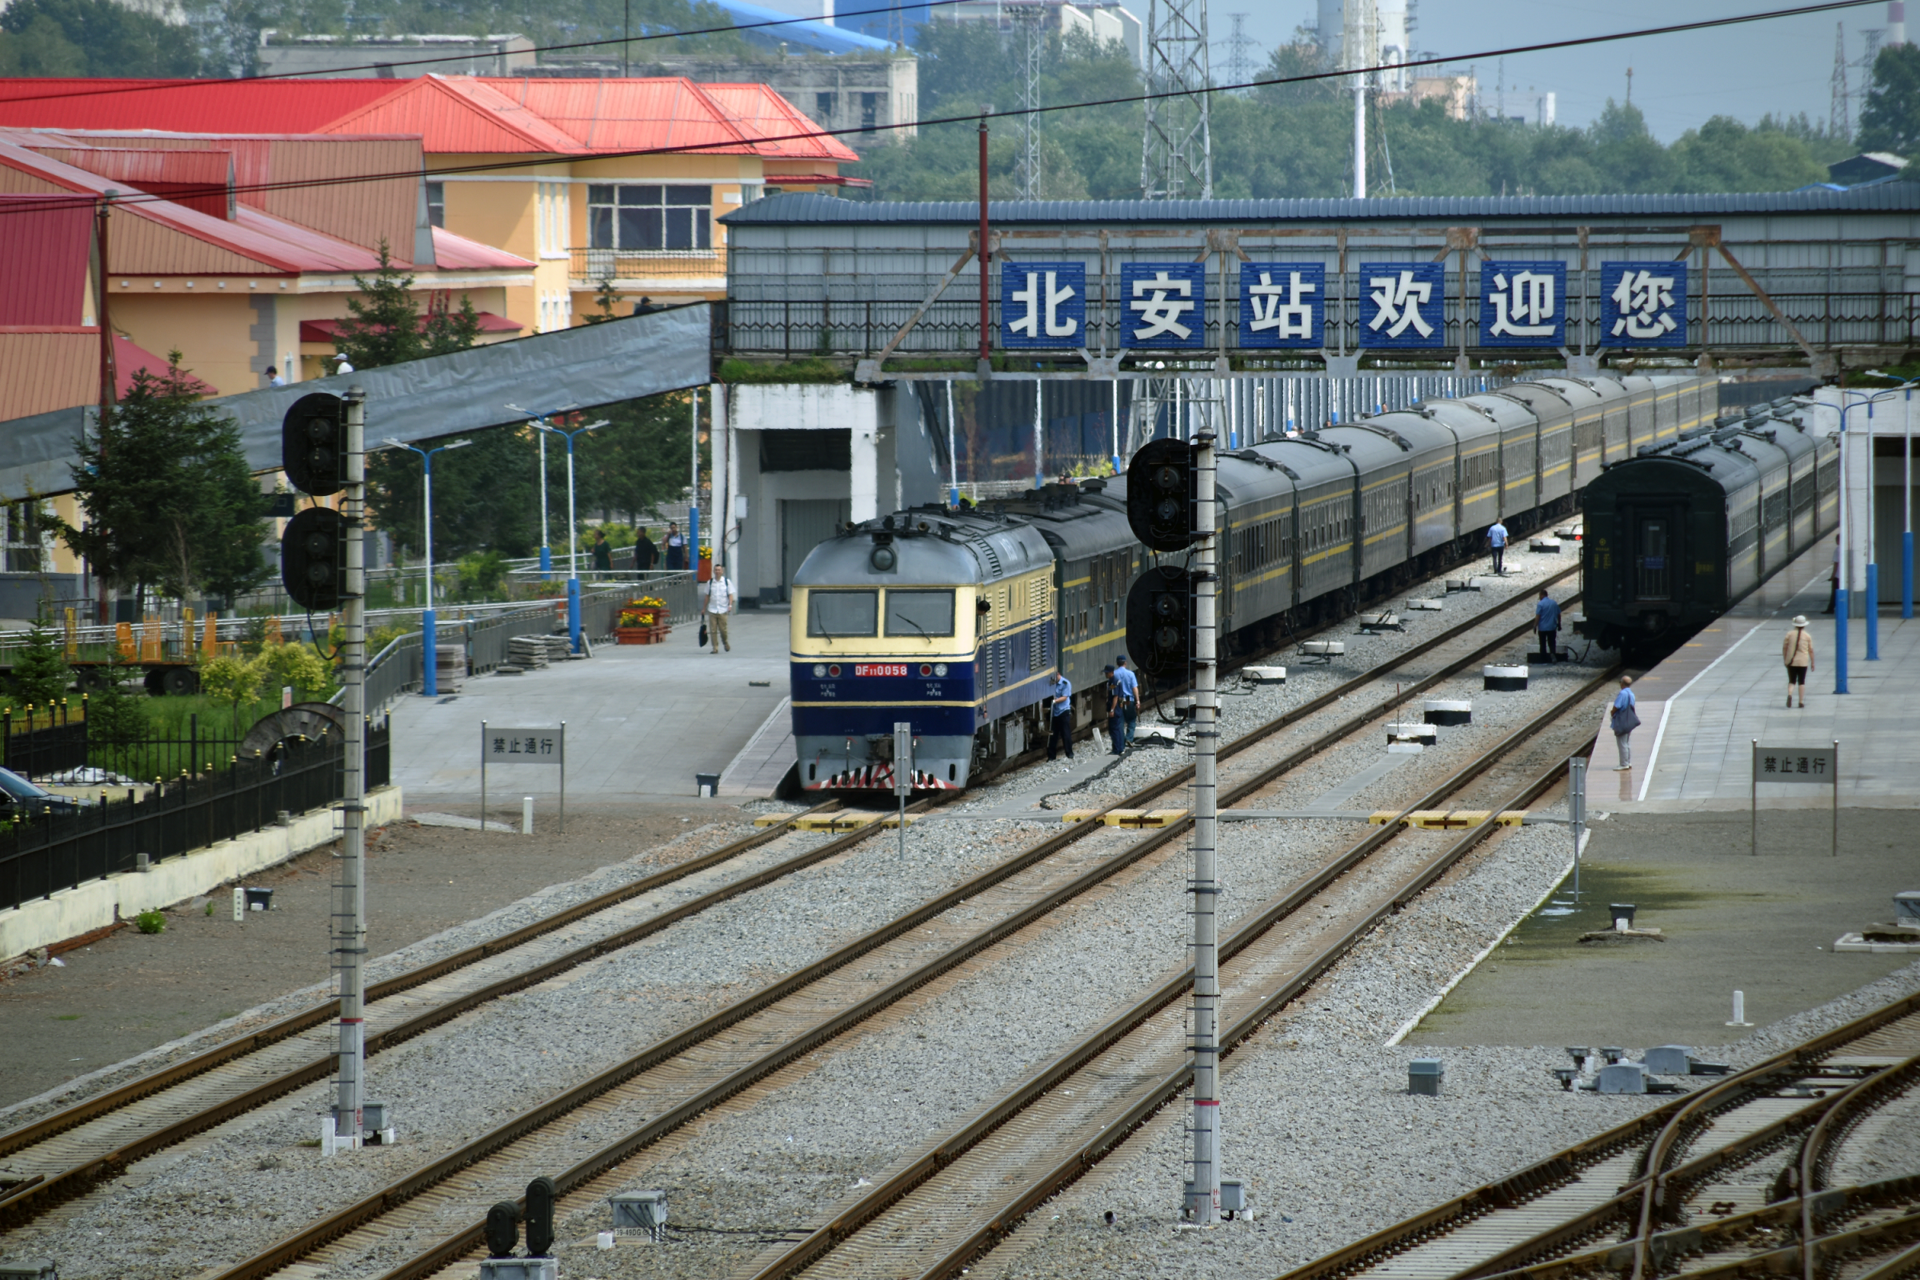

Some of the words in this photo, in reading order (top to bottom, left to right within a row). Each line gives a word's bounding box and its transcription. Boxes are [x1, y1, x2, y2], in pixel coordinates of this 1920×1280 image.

[1008, 270, 1678, 340] 北安站欢迎您
[493, 737, 553, 755] 禁止通行
[1764, 756, 1826, 774] 禁止通行
